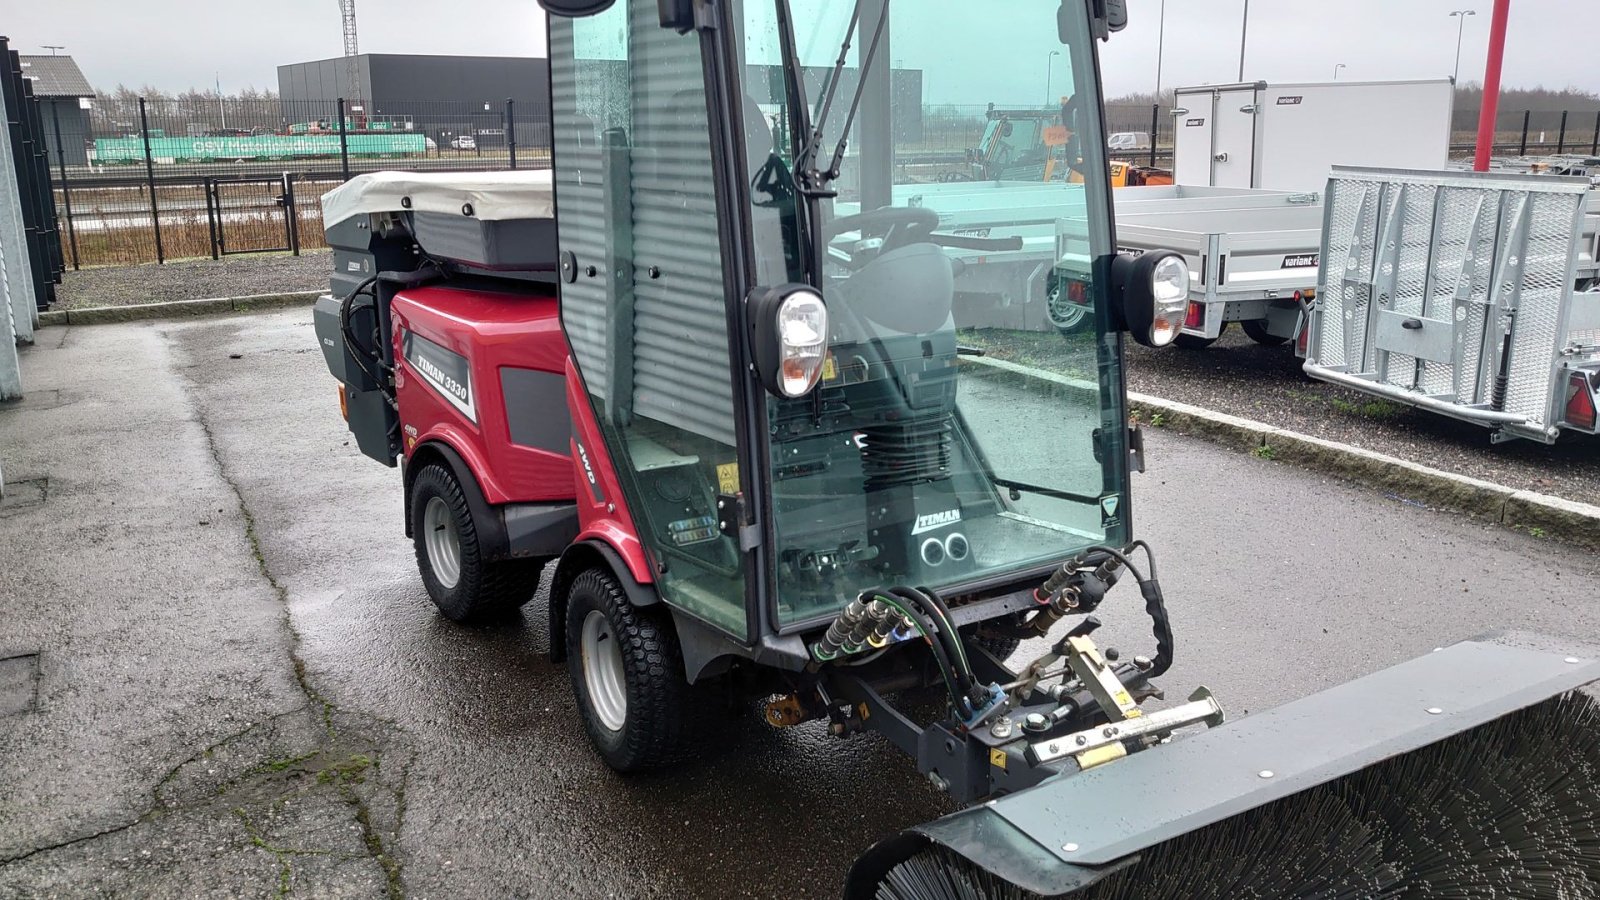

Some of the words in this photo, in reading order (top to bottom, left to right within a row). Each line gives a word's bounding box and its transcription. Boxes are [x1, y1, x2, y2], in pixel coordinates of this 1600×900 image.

[1285, 256, 1312, 267] variant
[417, 354, 446, 385] TIMAN
[444, 376, 467, 400] 3330
[577, 443, 596, 484] 4WD
[919, 508, 961, 527] TIMAN
